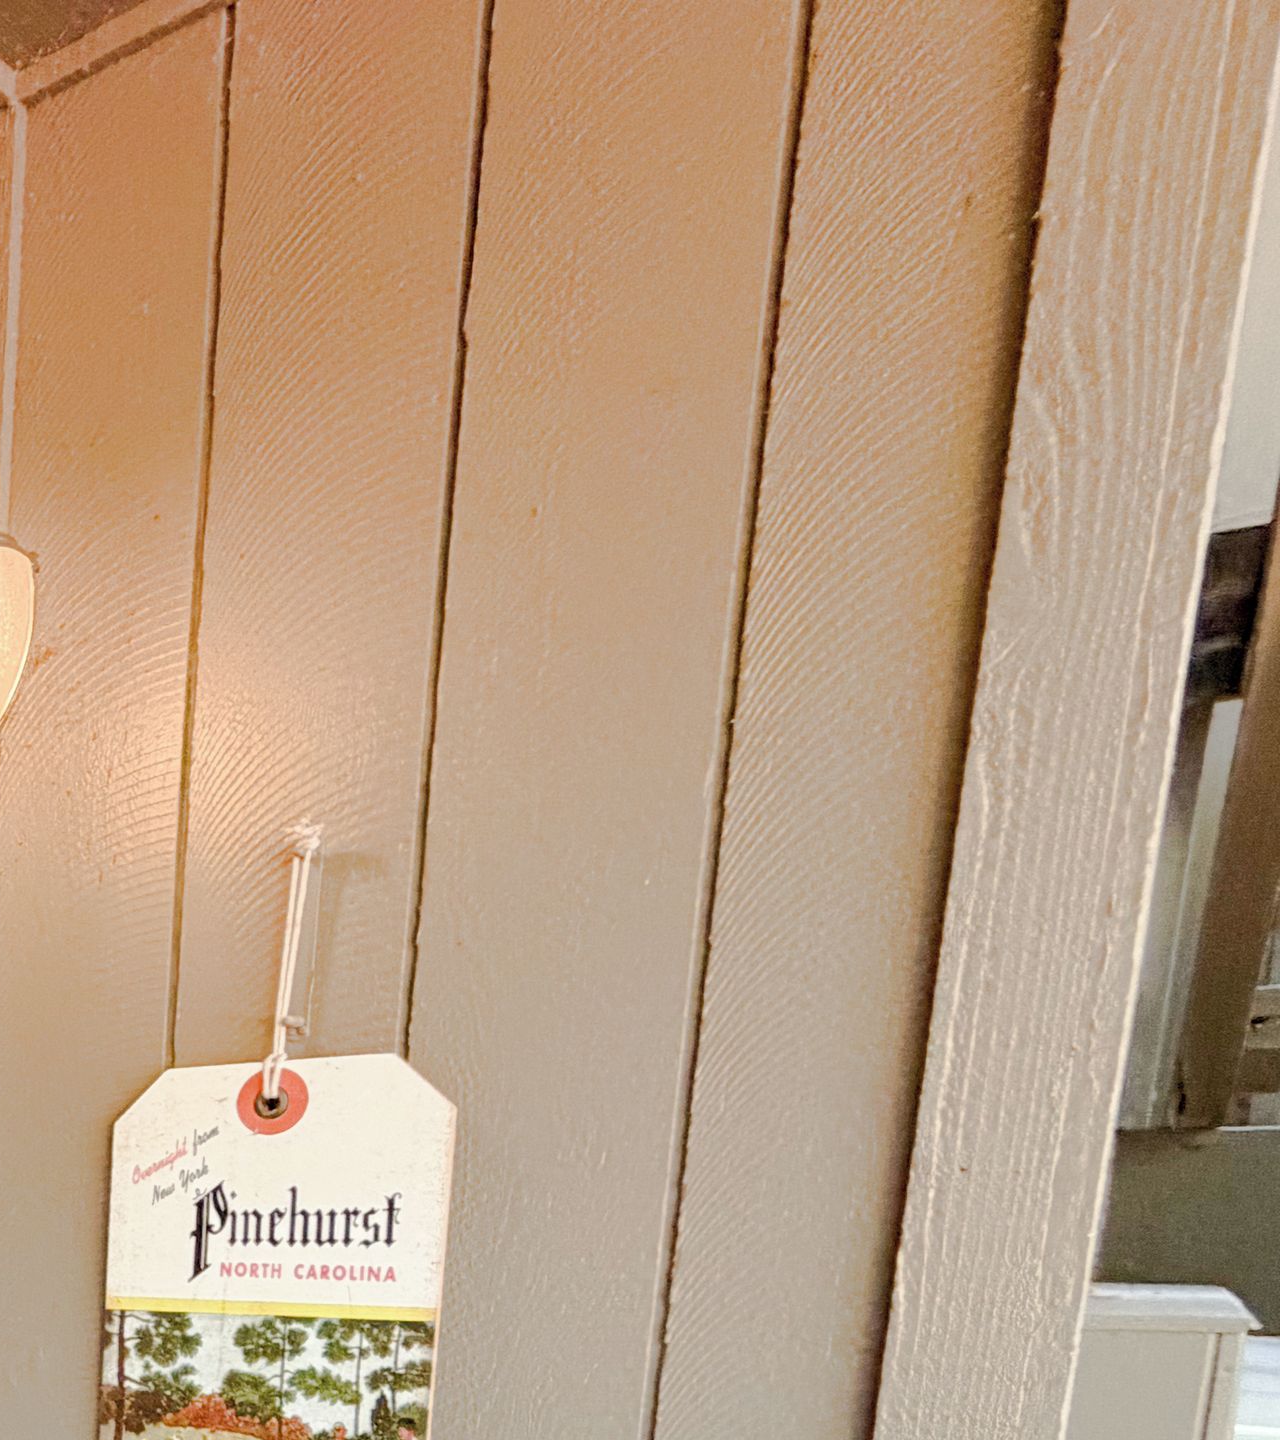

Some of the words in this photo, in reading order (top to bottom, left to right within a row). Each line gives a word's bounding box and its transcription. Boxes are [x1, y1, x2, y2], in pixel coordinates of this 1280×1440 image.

[131, 1135, 188, 1185] Overnight
[192, 1126, 220, 1157] from
[151, 1184, 175, 1206] New
[179, 1156, 209, 1193] York
[187, 1180, 403, 1283] Pinehurst
[219, 1262, 282, 1279] NORTH
[293, 1264, 397, 1282] CAROLINA
